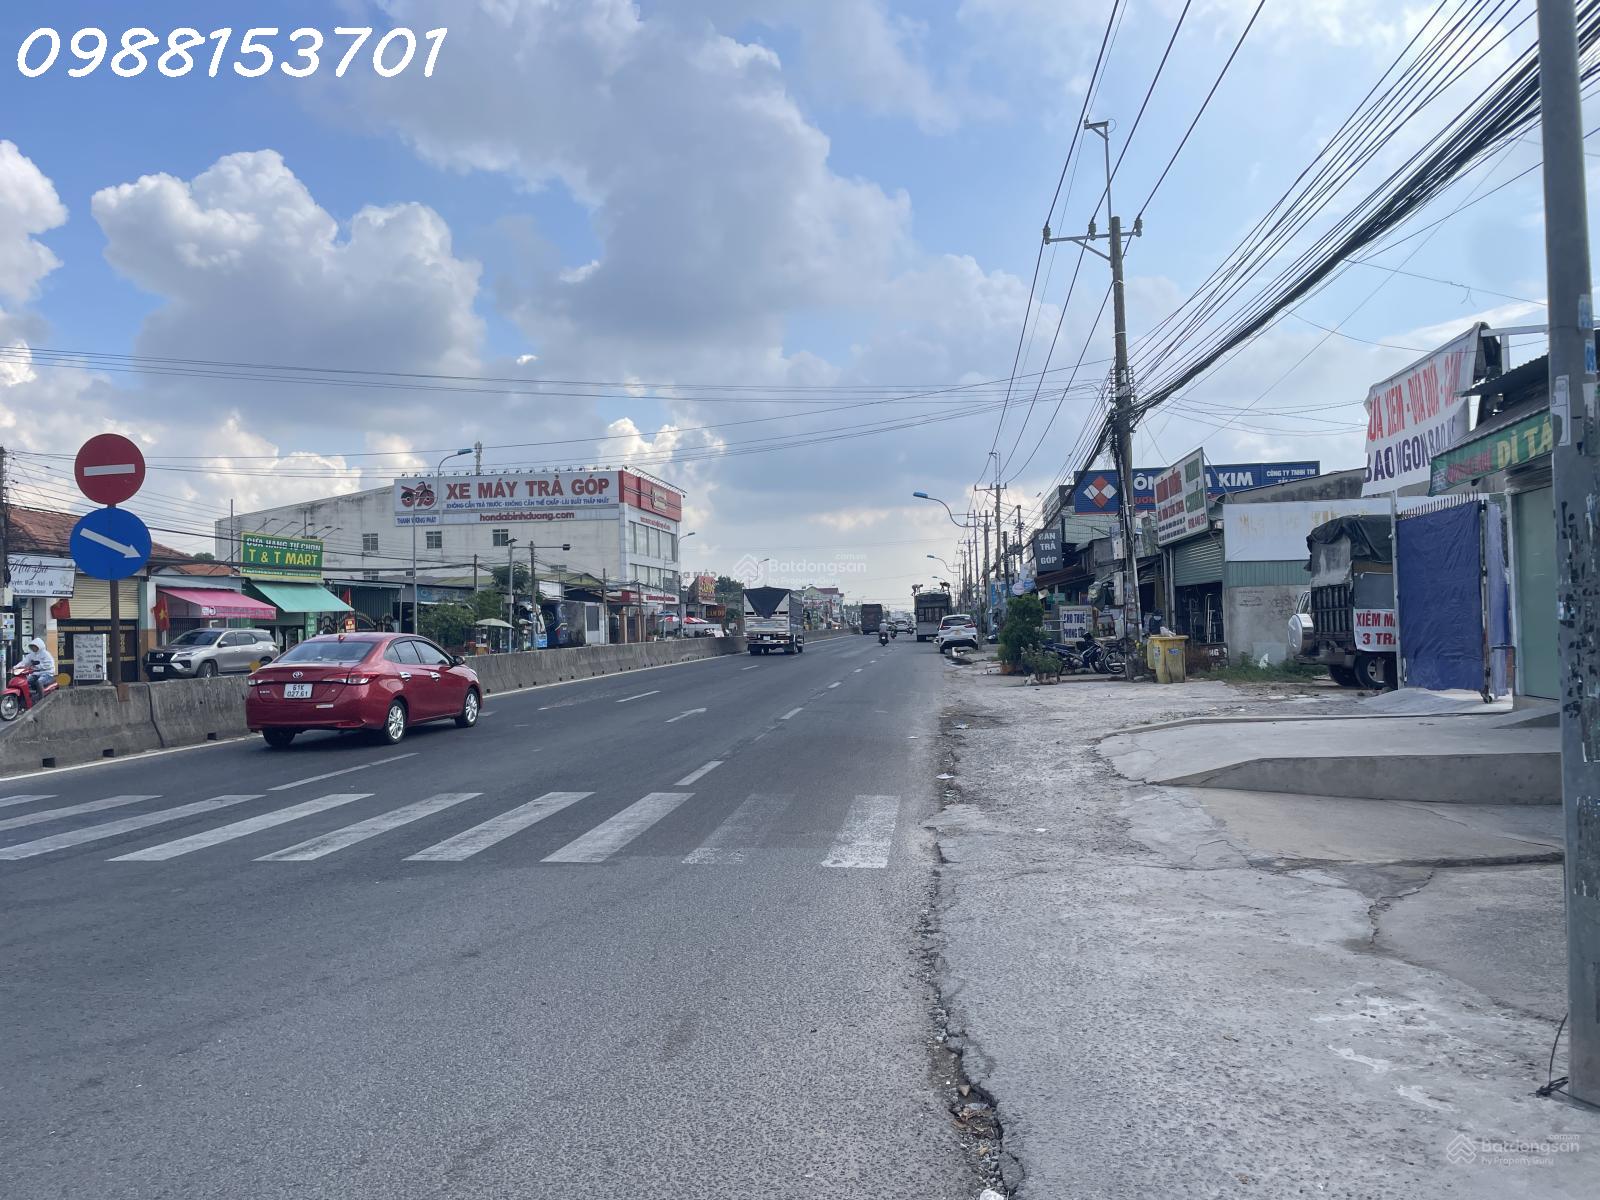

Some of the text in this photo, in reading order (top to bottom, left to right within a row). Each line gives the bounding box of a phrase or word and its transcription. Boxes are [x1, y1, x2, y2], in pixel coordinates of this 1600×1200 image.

[446, 474, 610, 500] XE MÁY TRẢ GÓP
[1218, 472, 1254, 487] KIM
[480, 511, 575, 522] hondabinhduong.com
[249, 548, 318, 566] T & T MART
[1040, 555, 1058, 565] GÓP
[1356, 610, 1381, 627] XIÊM
[1362, 632, 1371, 645] 3
